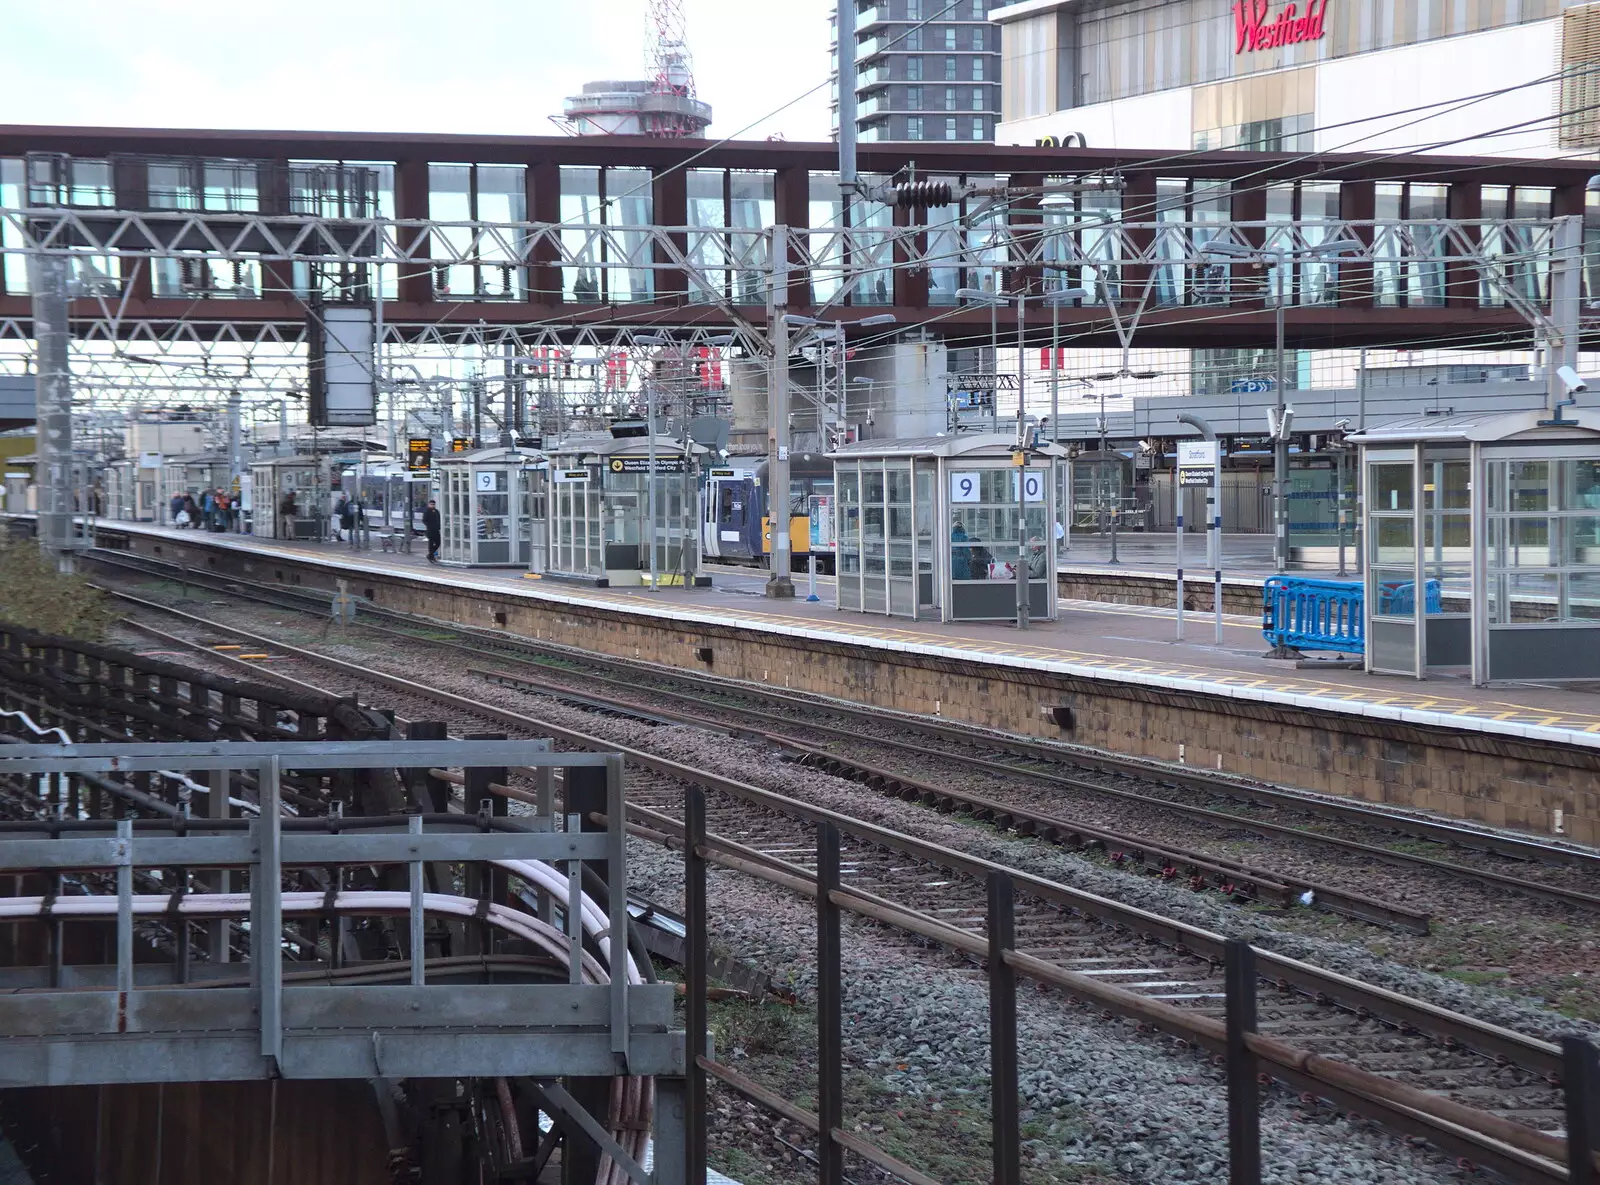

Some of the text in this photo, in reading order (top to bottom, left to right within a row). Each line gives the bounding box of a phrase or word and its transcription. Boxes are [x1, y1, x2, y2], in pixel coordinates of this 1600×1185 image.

[1232, 0, 1325, 54] Westfield
[1248, 382, 1257, 392] P
[482, 475, 491, 487] 9
[960, 478, 973, 496] 9
[1026, 477, 1038, 496] 0
